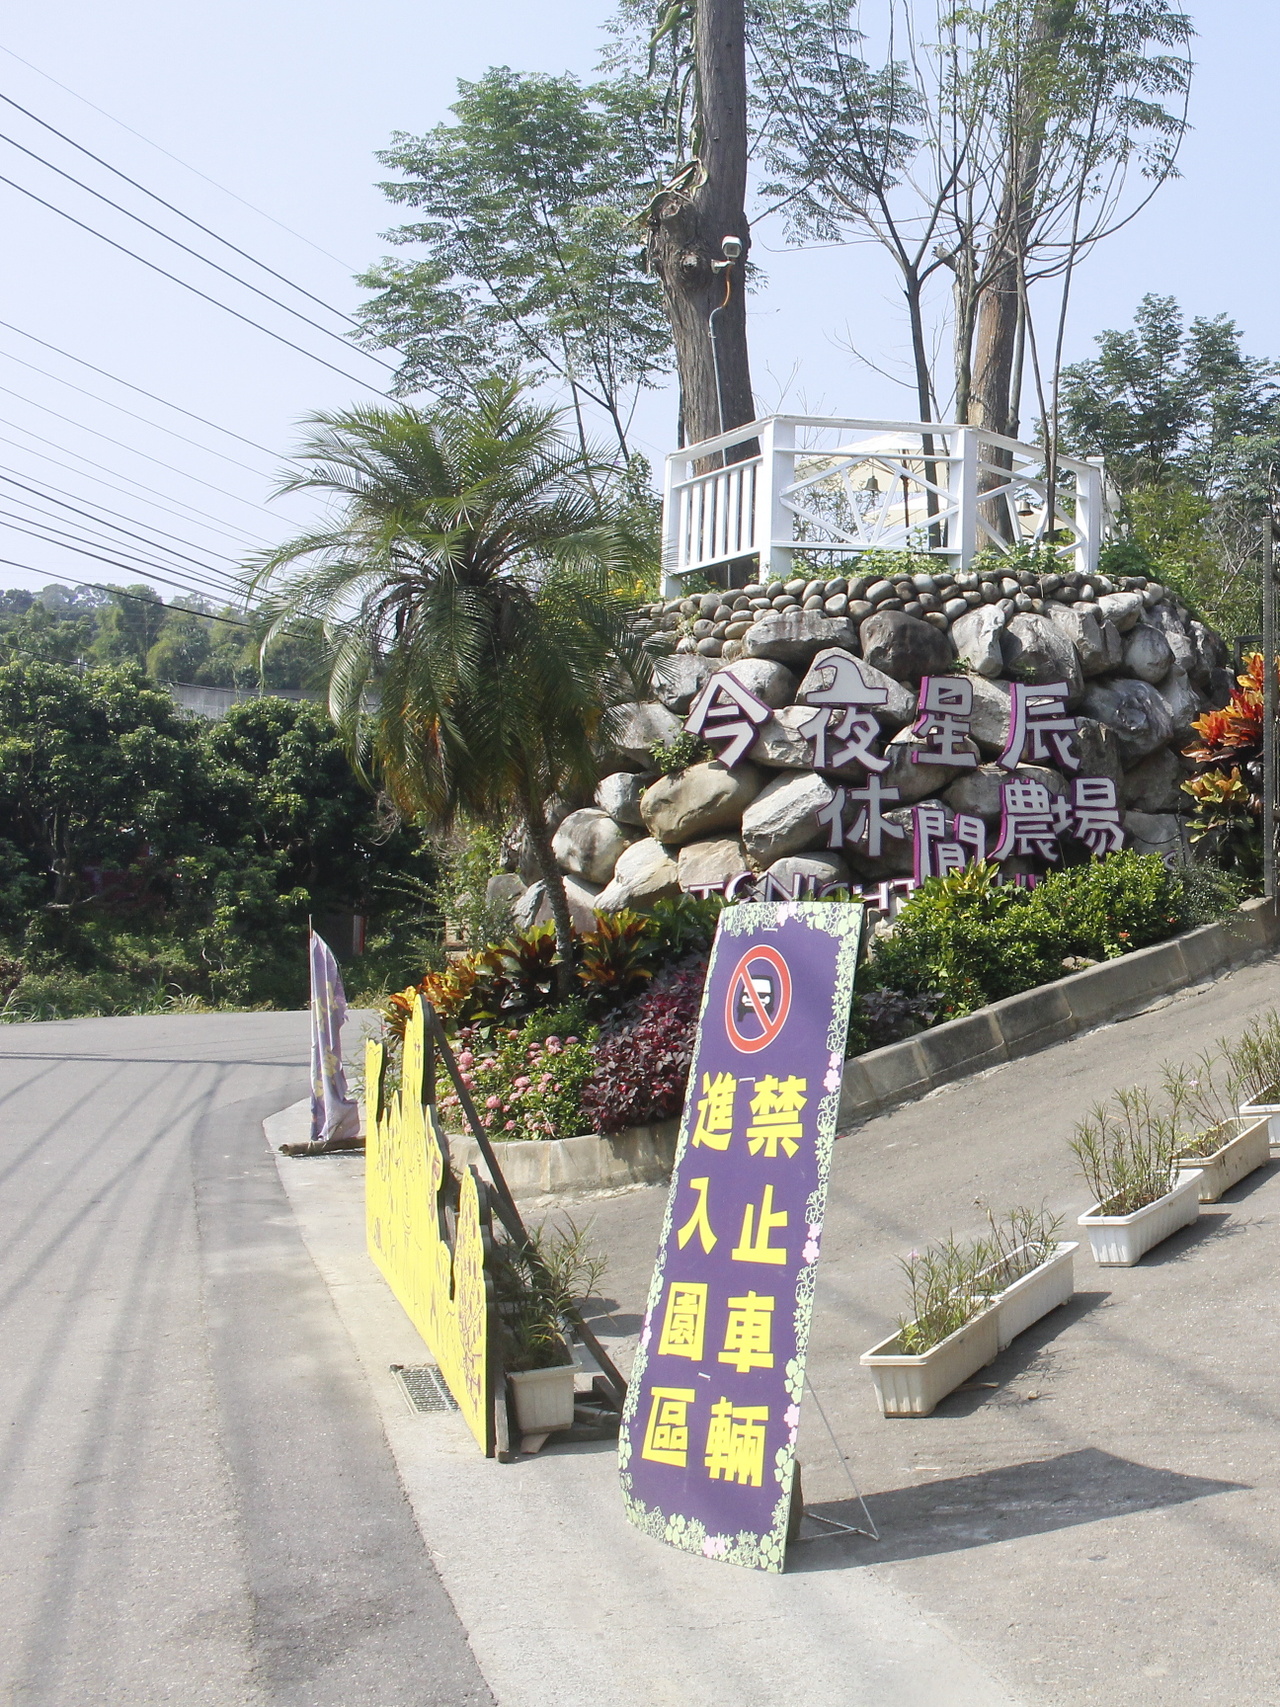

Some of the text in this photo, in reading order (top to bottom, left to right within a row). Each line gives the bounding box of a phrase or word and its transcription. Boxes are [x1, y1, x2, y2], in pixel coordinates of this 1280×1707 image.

[684, 654, 1082, 772] 今夜星辰
[641, 1070, 736, 1469] 進入園區
[704, 1074, 808, 1488] 禁止車輛
